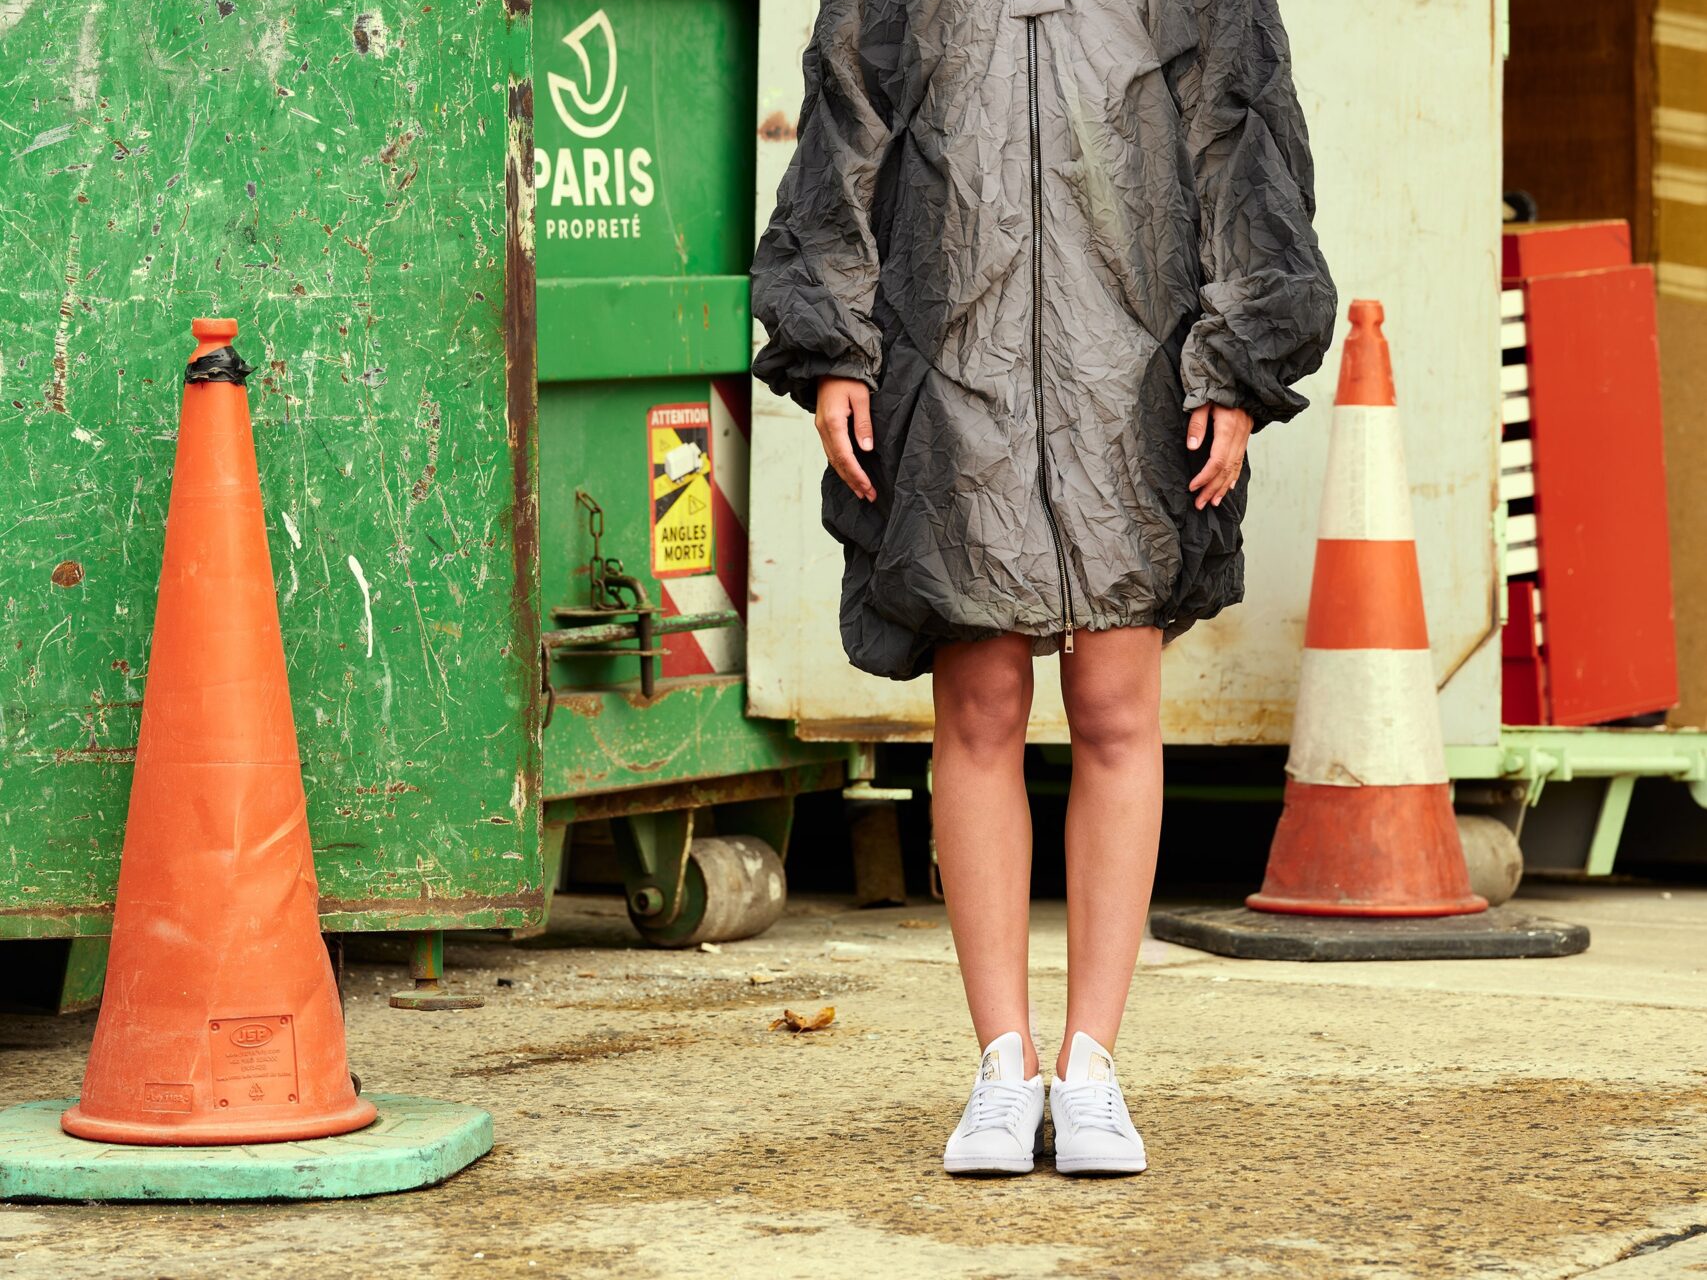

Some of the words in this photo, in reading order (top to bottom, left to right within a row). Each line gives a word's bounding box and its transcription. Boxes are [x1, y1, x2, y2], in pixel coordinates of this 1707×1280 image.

[534, 147, 655, 207] PARIS
[546, 214, 641, 239] PROPRETÉ
[651, 408, 709, 426] ATTENTION
[661, 524, 707, 543] ANGLES
[664, 543, 705, 562] MORTS
